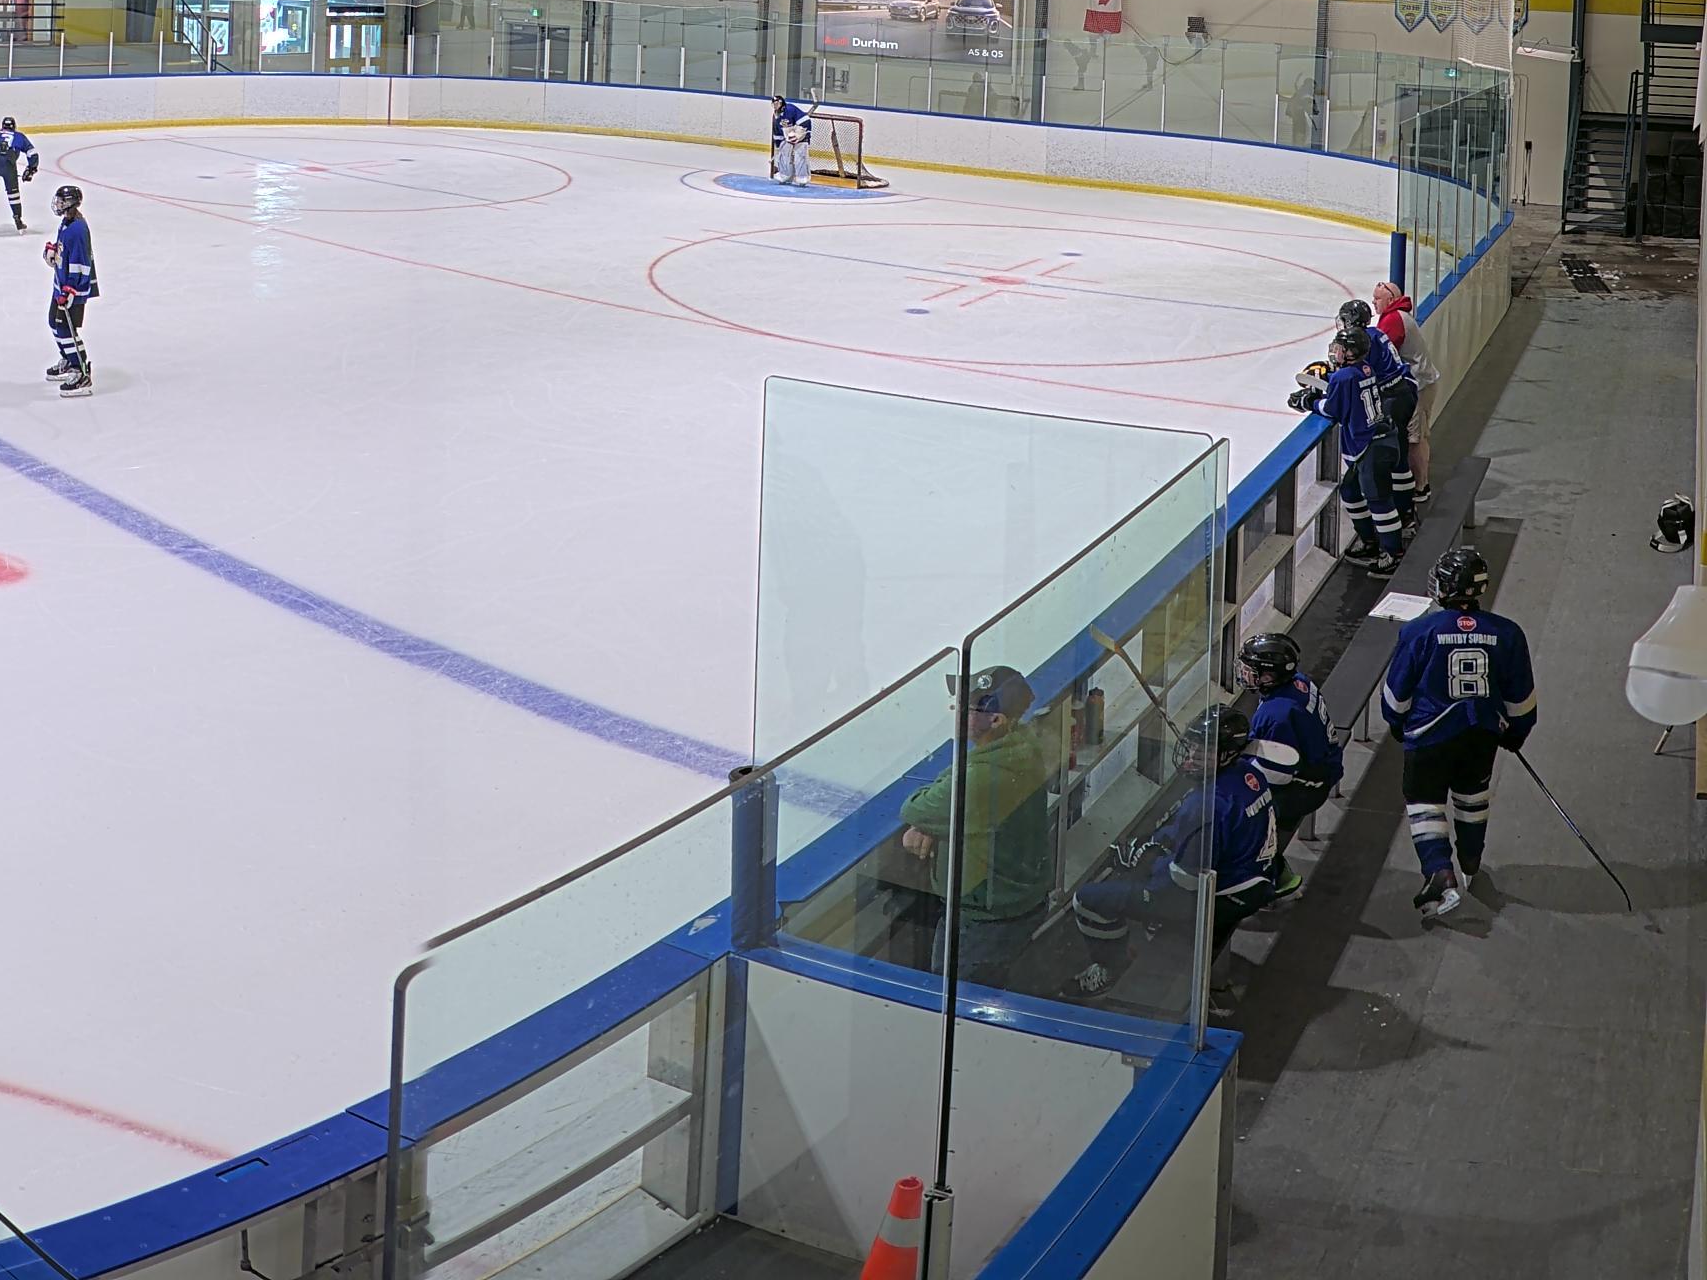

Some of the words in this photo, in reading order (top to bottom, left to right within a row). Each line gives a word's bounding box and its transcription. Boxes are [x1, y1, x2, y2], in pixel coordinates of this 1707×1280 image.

[824, 35, 849, 46] Audi
[852, 37, 899, 50] Durham
[1457, 618, 1476, 627] STOP
[1437, 633, 1467, 645] WHITBY
[1468, 633, 1497, 646] SUBARU
[1447, 647, 1490, 699] 8
